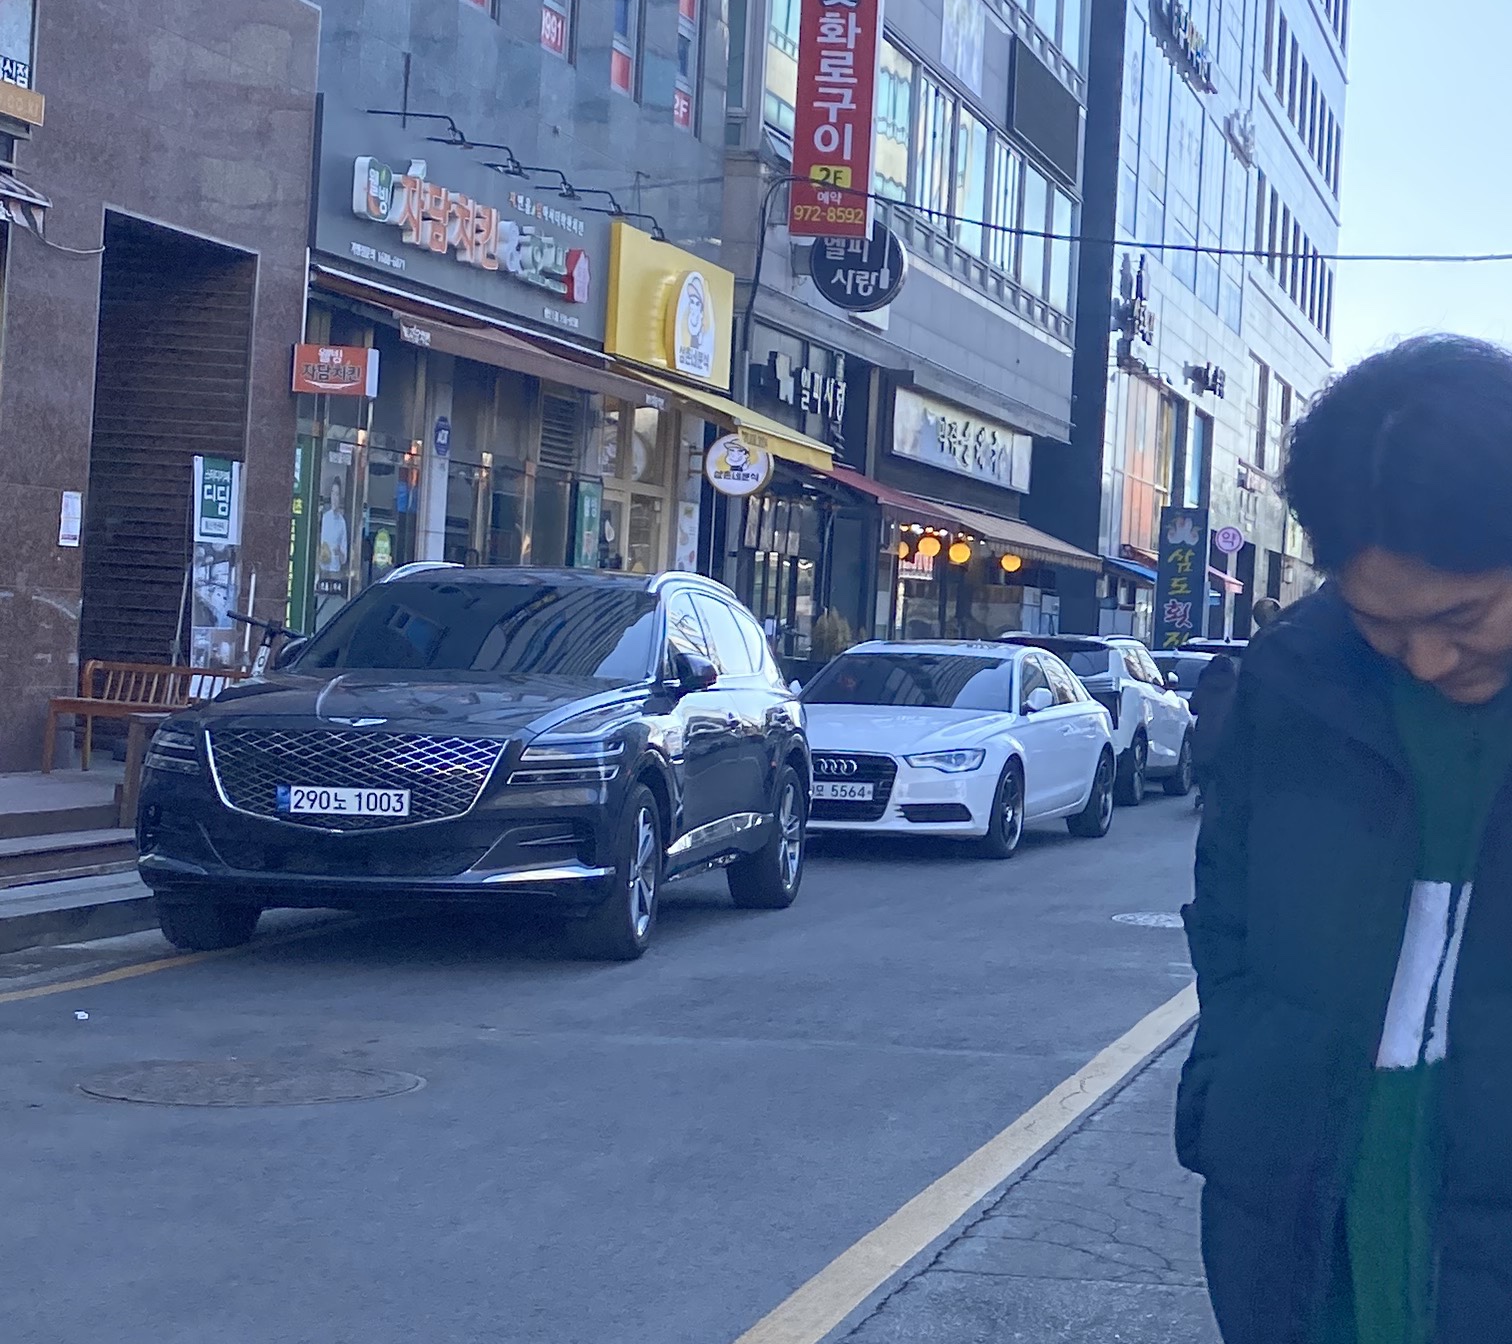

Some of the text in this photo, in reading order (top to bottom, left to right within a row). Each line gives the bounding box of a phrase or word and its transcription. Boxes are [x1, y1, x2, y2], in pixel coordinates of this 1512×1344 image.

[0, 60, 29, 88] 신점
[817, 191, 842, 205] 예약
[793, 204, 865, 225] 972-8592
[831, 268, 879, 297] 사랑
[302, 364, 361, 382] 자담치킨
[204, 484, 230, 516] 디딤
[1220, 531, 1237, 547] 약
[293, 789, 404, 812] 290노 1003
[831, 784, 866, 798] 5564
